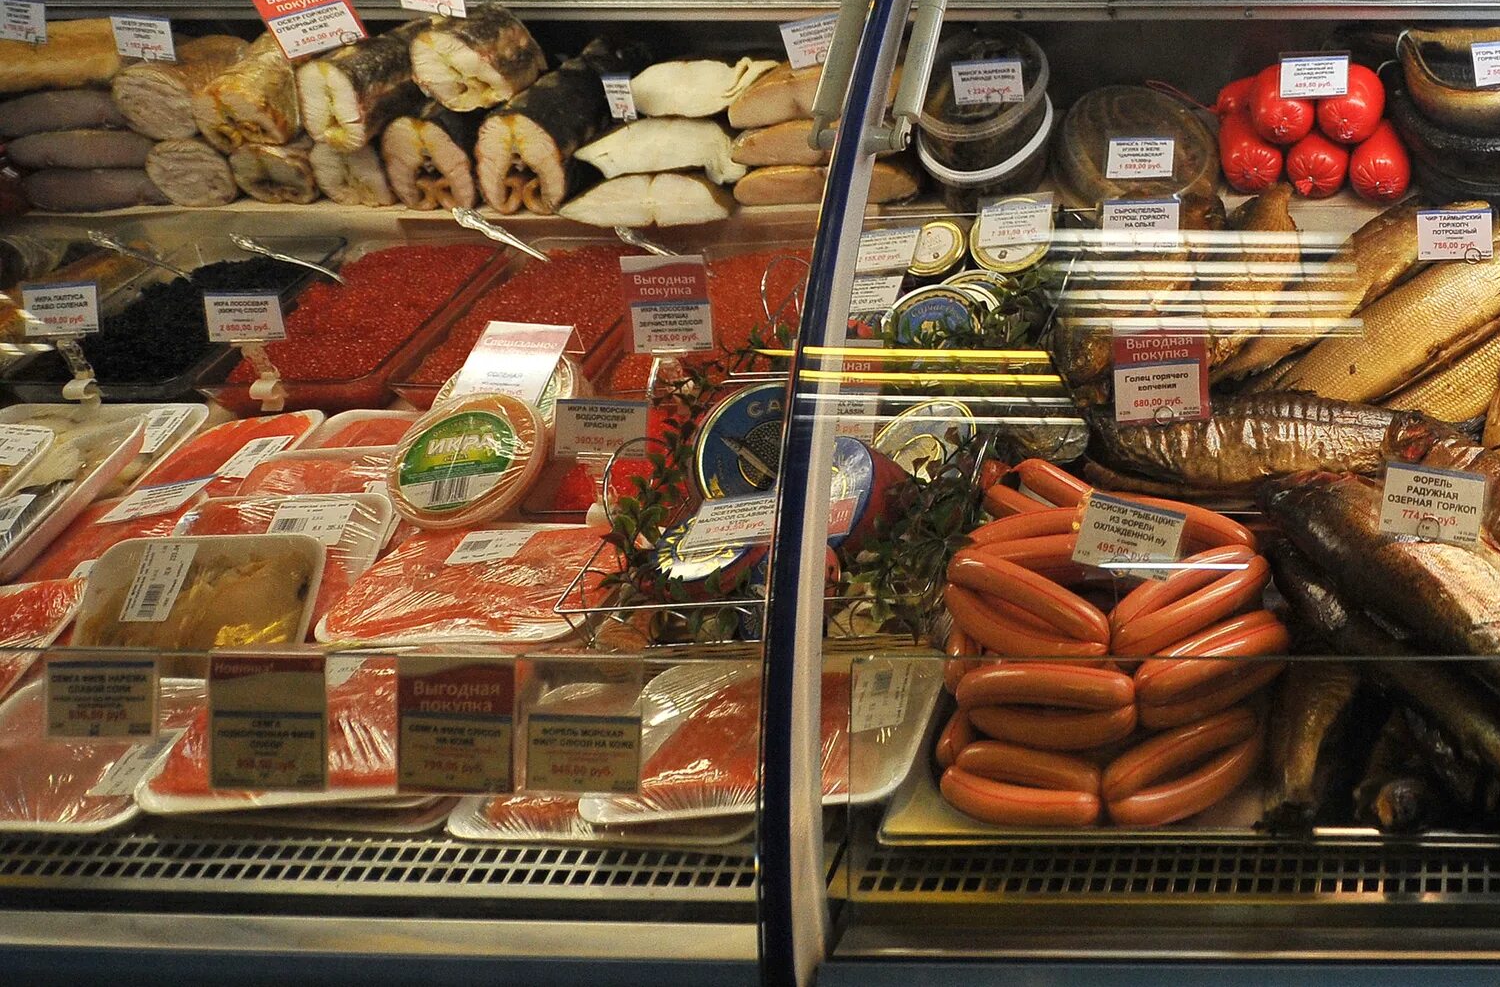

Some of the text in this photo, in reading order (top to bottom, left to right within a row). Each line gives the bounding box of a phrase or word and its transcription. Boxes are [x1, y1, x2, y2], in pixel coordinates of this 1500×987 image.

[634, 275, 696, 286] Выгодная
[640, 287, 692, 297] покупка
[1126, 337, 1193, 349] Выгодная
[1133, 350, 1188, 361] покупка
[1152, 373, 1188, 381] горячего
[1134, 397, 1183, 408] 680,00 руб.
[428, 433, 494, 456] ИКРА
[1413, 475, 1452, 488] ФОРЕЛЬ
[1407, 486, 1458, 500] РАДУЖНАЯ
[1388, 494, 1476, 514] ОЗЕРНАЯ ГОР/КОП
[1090, 500, 1180, 527] СОСИСКИ "РЫБАЦКИЕ"
[1109, 515, 1154, 532] ИЗ ФОРЕЛИ
[1438, 516, 1458, 526] руб.
[1094, 522, 1154, 543] ОХЛАЖДЕННОЙ
[413, 681, 500, 698] Выгодная
[420, 701, 492, 712] покупка
